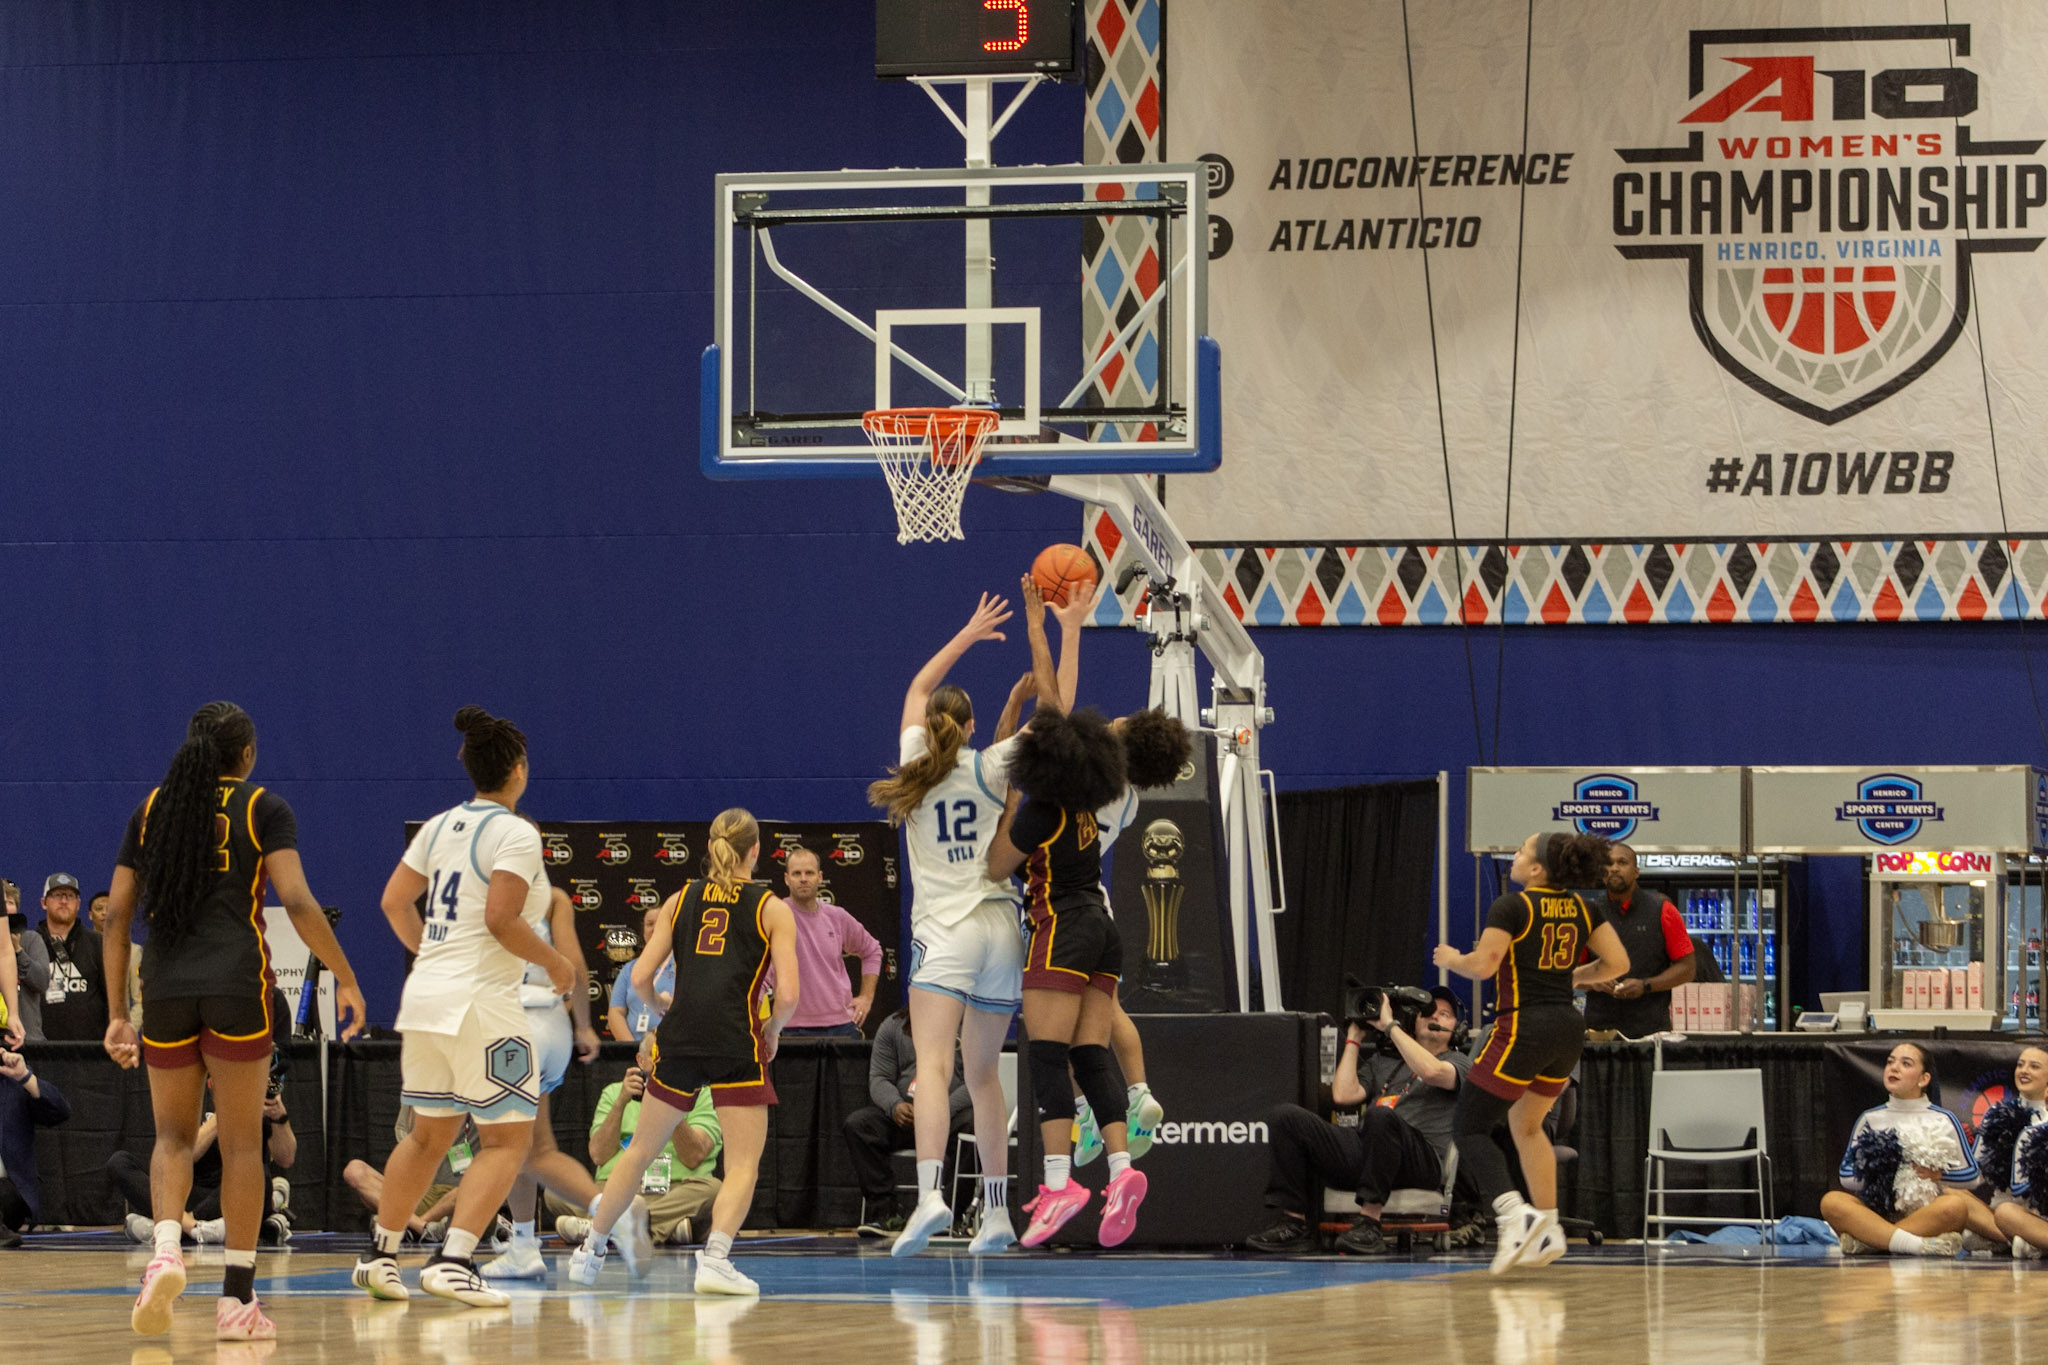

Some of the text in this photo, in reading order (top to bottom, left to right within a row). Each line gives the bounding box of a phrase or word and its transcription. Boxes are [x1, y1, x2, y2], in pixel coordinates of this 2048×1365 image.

[1678, 55, 1979, 123] A10
[1718, 133, 1942, 160] WOMEN'S
[1268, 153, 1575, 190] A10CONFERENCE
[1613, 164, 2048, 236] CHAMPIONSHIP
[1268, 216, 1482, 252] ATLANTIC10
[1717, 238, 1942, 262] HENRICO, VIRGINIA
[1706, 451, 1955, 496] #A10WBB
[1133, 504, 1173, 577] GARED
[934, 800, 977, 843] 12
[1563, 805, 1601, 814] SPORTS
[1611, 805, 1649, 814] EVENTS
[1846, 805, 1885, 814] SPORTS
[1895, 805, 1934, 814] EVENTS
[1876, 851, 1991, 872] POP CORN
[426, 868, 462, 921] 14
[702, 882, 741, 904] KINAS
[695, 907, 731, 956] 2
[1538, 923, 1578, 969] 13
[275, 968, 305, 977] OPHY
[1151, 1121, 1269, 1144] termen
